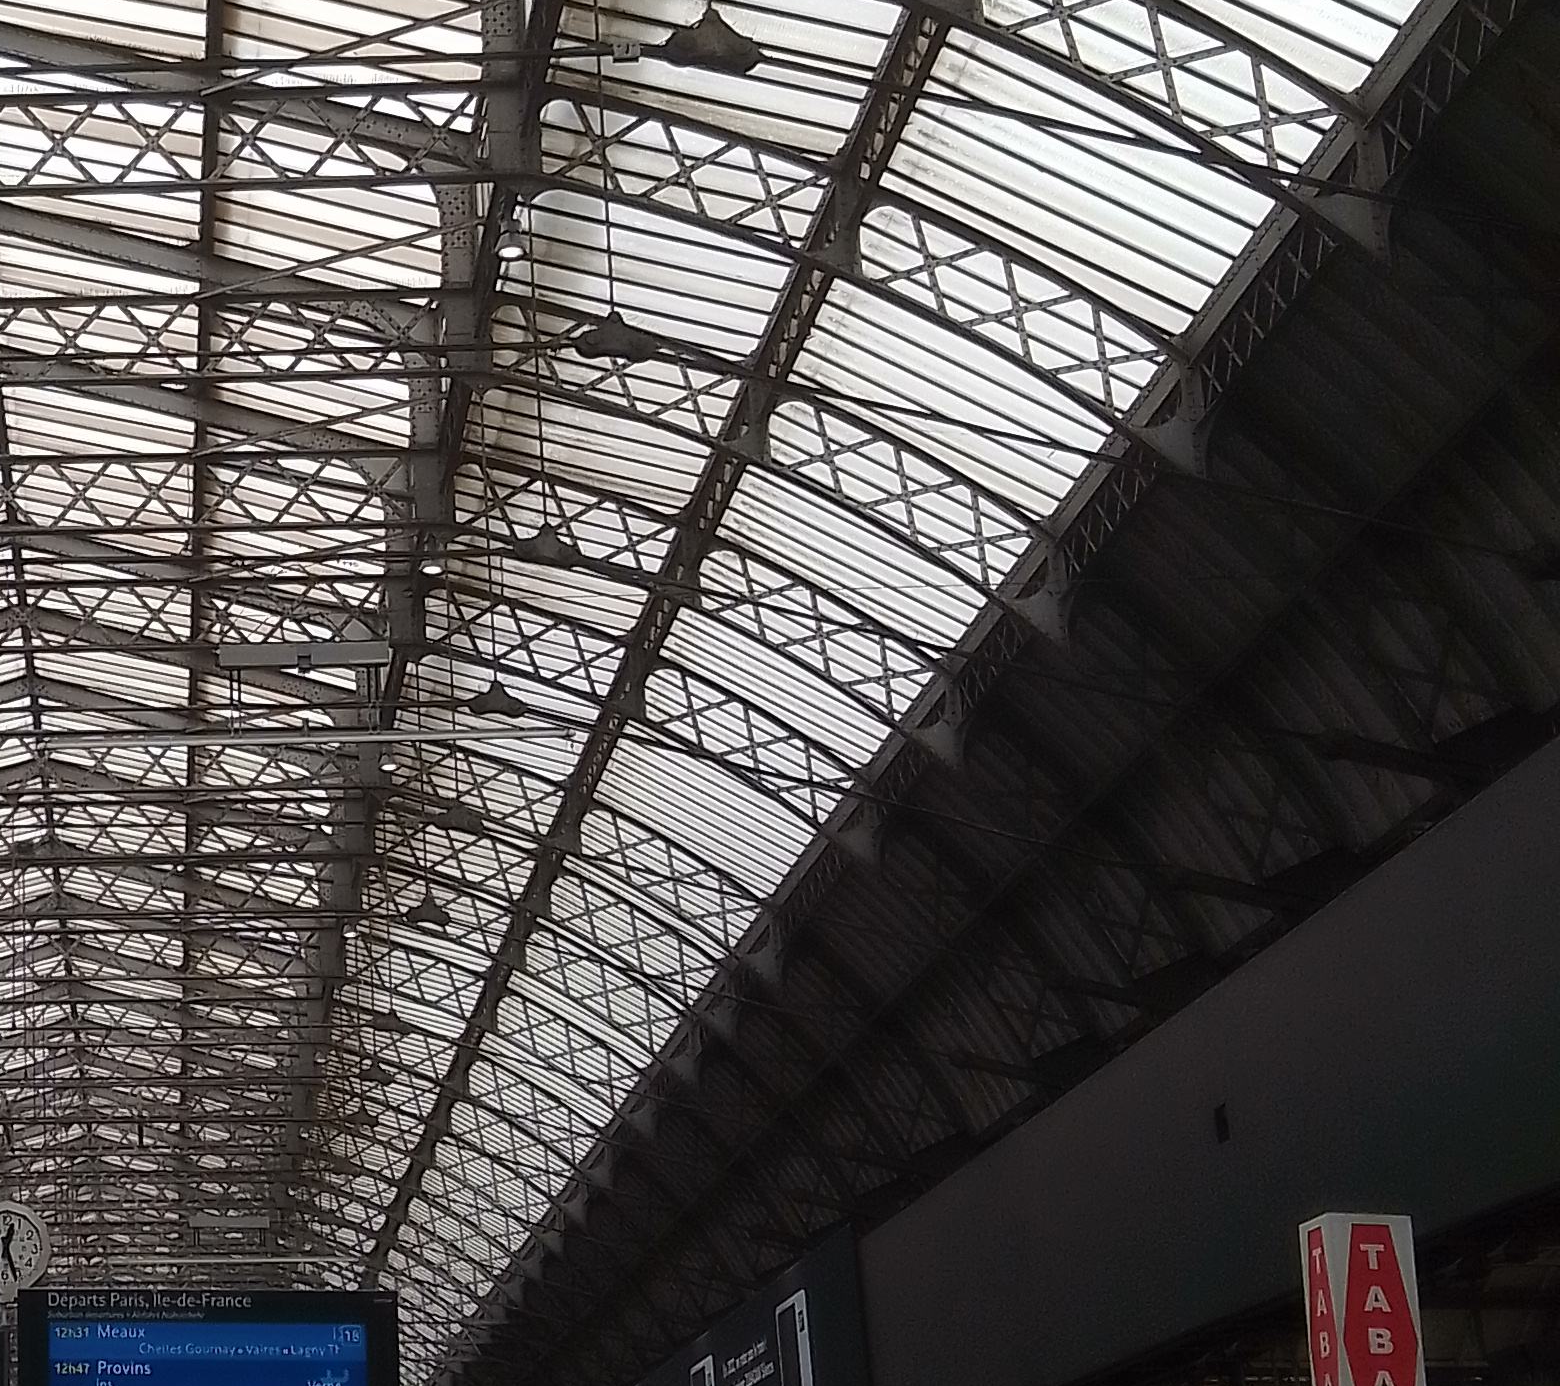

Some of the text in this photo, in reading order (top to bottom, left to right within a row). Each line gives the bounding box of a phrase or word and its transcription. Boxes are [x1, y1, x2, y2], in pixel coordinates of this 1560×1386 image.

[47, 1293, 107, 1311] Départs
[109, 1292, 151, 1311] Paris,
[97, 1324, 147, 1340] Meaux
[343, 1329, 360, 1343] 18
[185, 1343, 237, 1358] Gournay
[245, 1343, 280, 1357] Vaires
[290, 1344, 325, 1359] Lagny
[53, 1360, 153, 1377] 12h47 Provins
